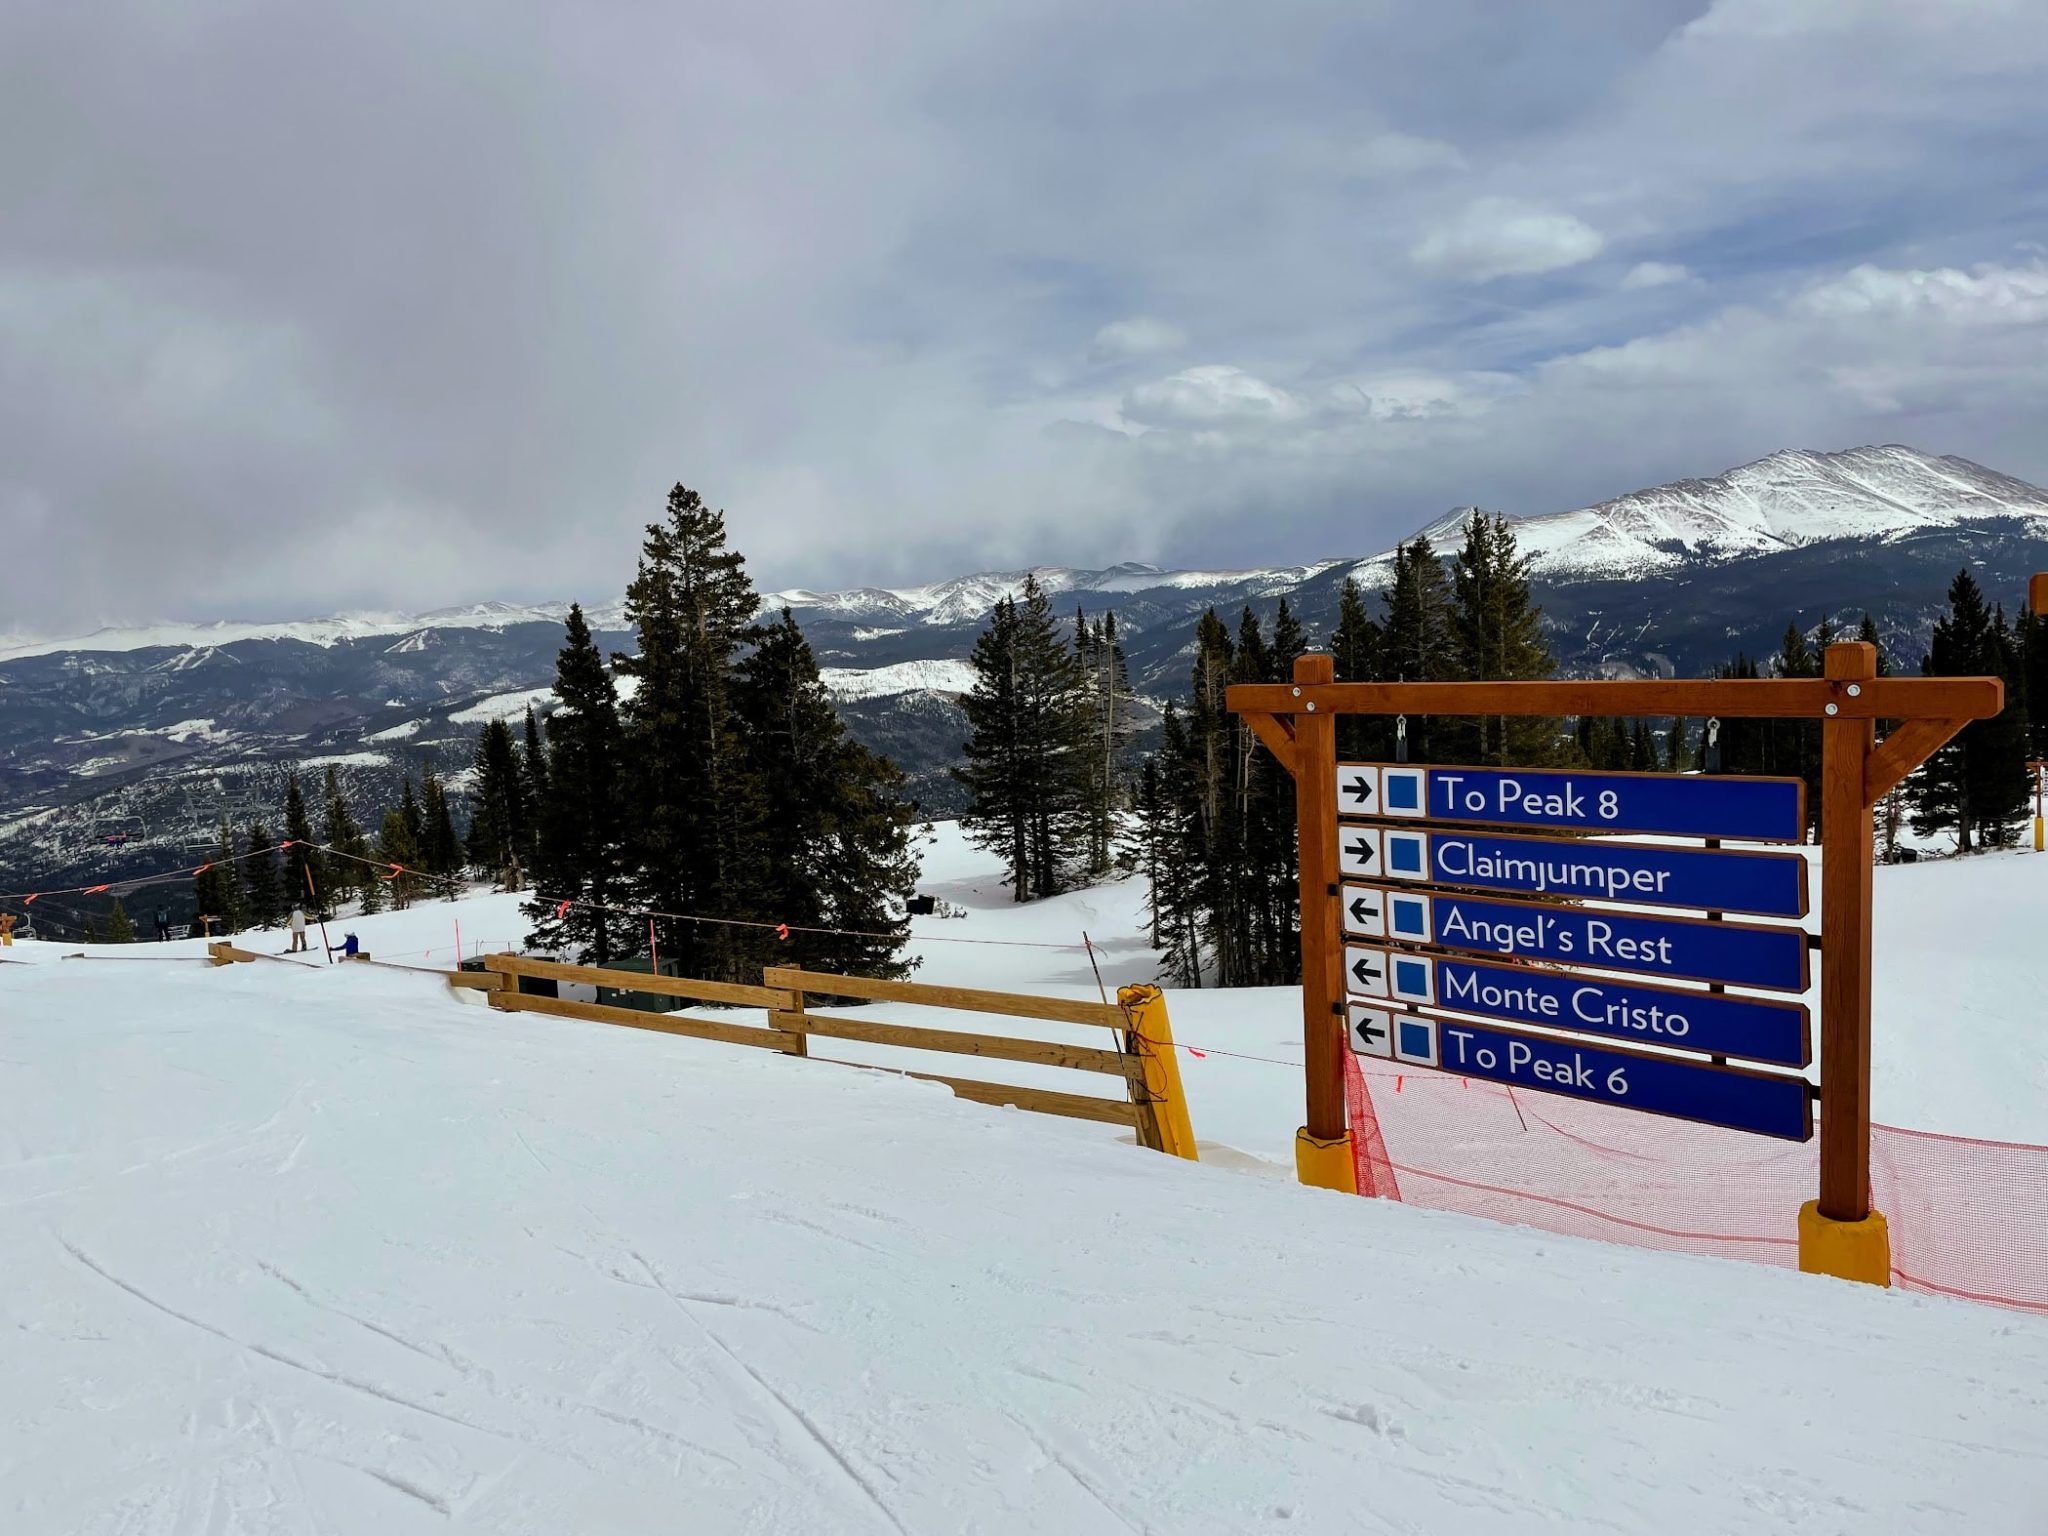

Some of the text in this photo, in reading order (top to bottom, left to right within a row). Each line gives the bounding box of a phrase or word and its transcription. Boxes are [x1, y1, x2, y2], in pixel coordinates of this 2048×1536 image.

[1437, 776, 1619, 820] To Peak 8
[1436, 841, 1671, 898] Claimjumper
[1442, 904, 1672, 965] Angel's Rest
[1445, 967, 1690, 1036] Monte Cristo
[1448, 1029, 1628, 1095] To Peak 6
